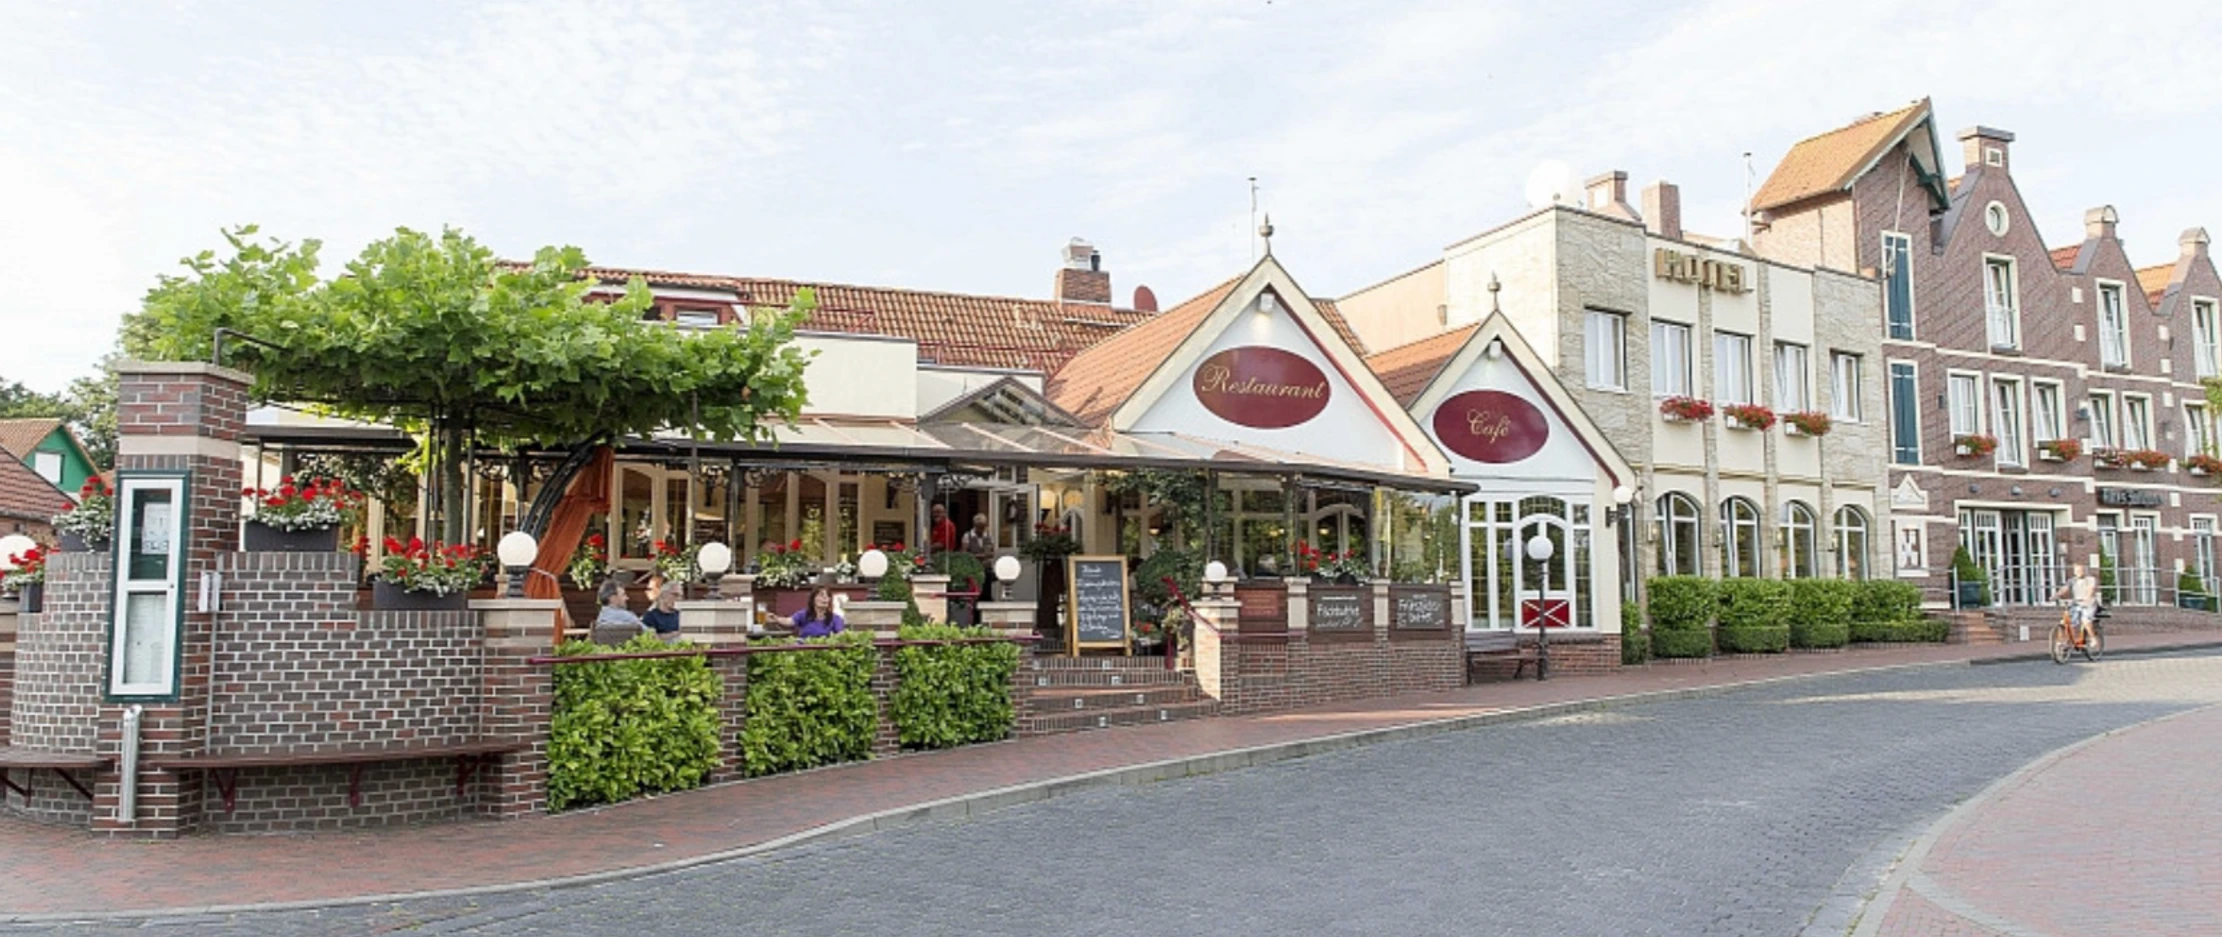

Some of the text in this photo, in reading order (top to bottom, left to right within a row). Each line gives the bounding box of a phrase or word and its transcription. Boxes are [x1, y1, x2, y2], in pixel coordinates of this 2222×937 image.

[1655, 248, 1754, 294] HOTEL
[1201, 363, 1326, 398] Restaurant
[1466, 408, 1511, 444] Café
